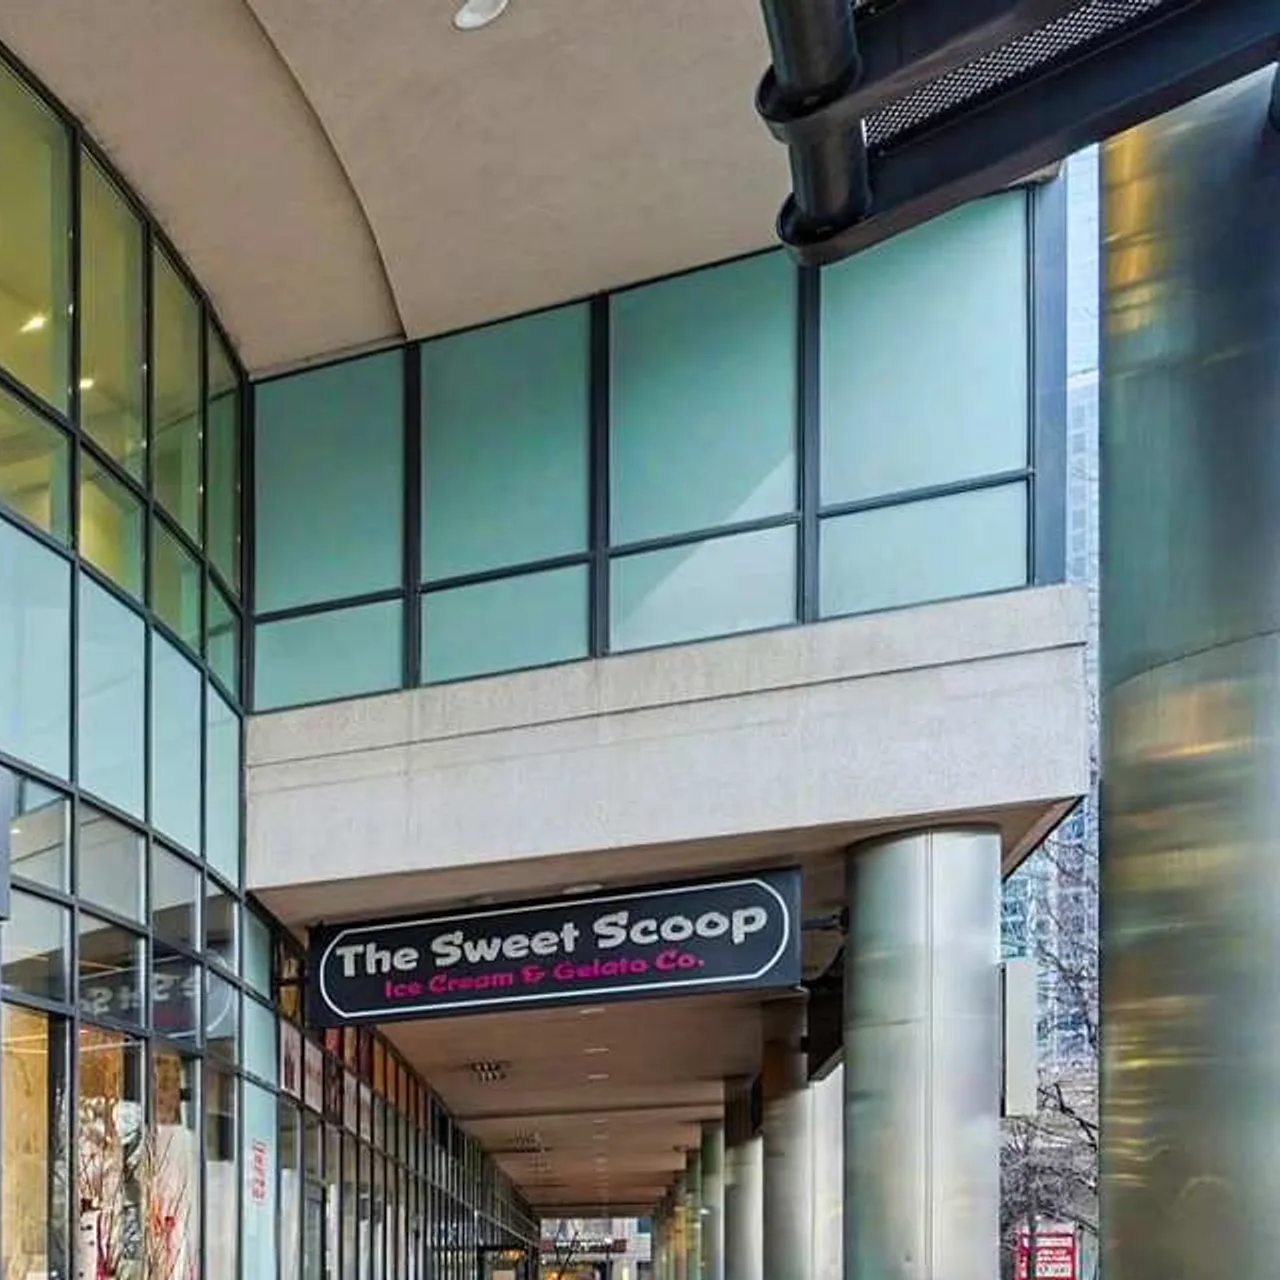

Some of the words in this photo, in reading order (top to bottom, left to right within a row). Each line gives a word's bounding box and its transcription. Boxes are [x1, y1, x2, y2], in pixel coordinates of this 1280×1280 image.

[336, 942, 419, 978] The
[430, 921, 580, 967] Sweet
[592, 905, 768, 949] Scoop
[384, 979, 422, 999] Ice
[429, 971, 514, 994] Cream
[521, 965, 547, 984] &
[554, 957, 648, 983] Gelato
[655, 947, 706, 973] Co.
